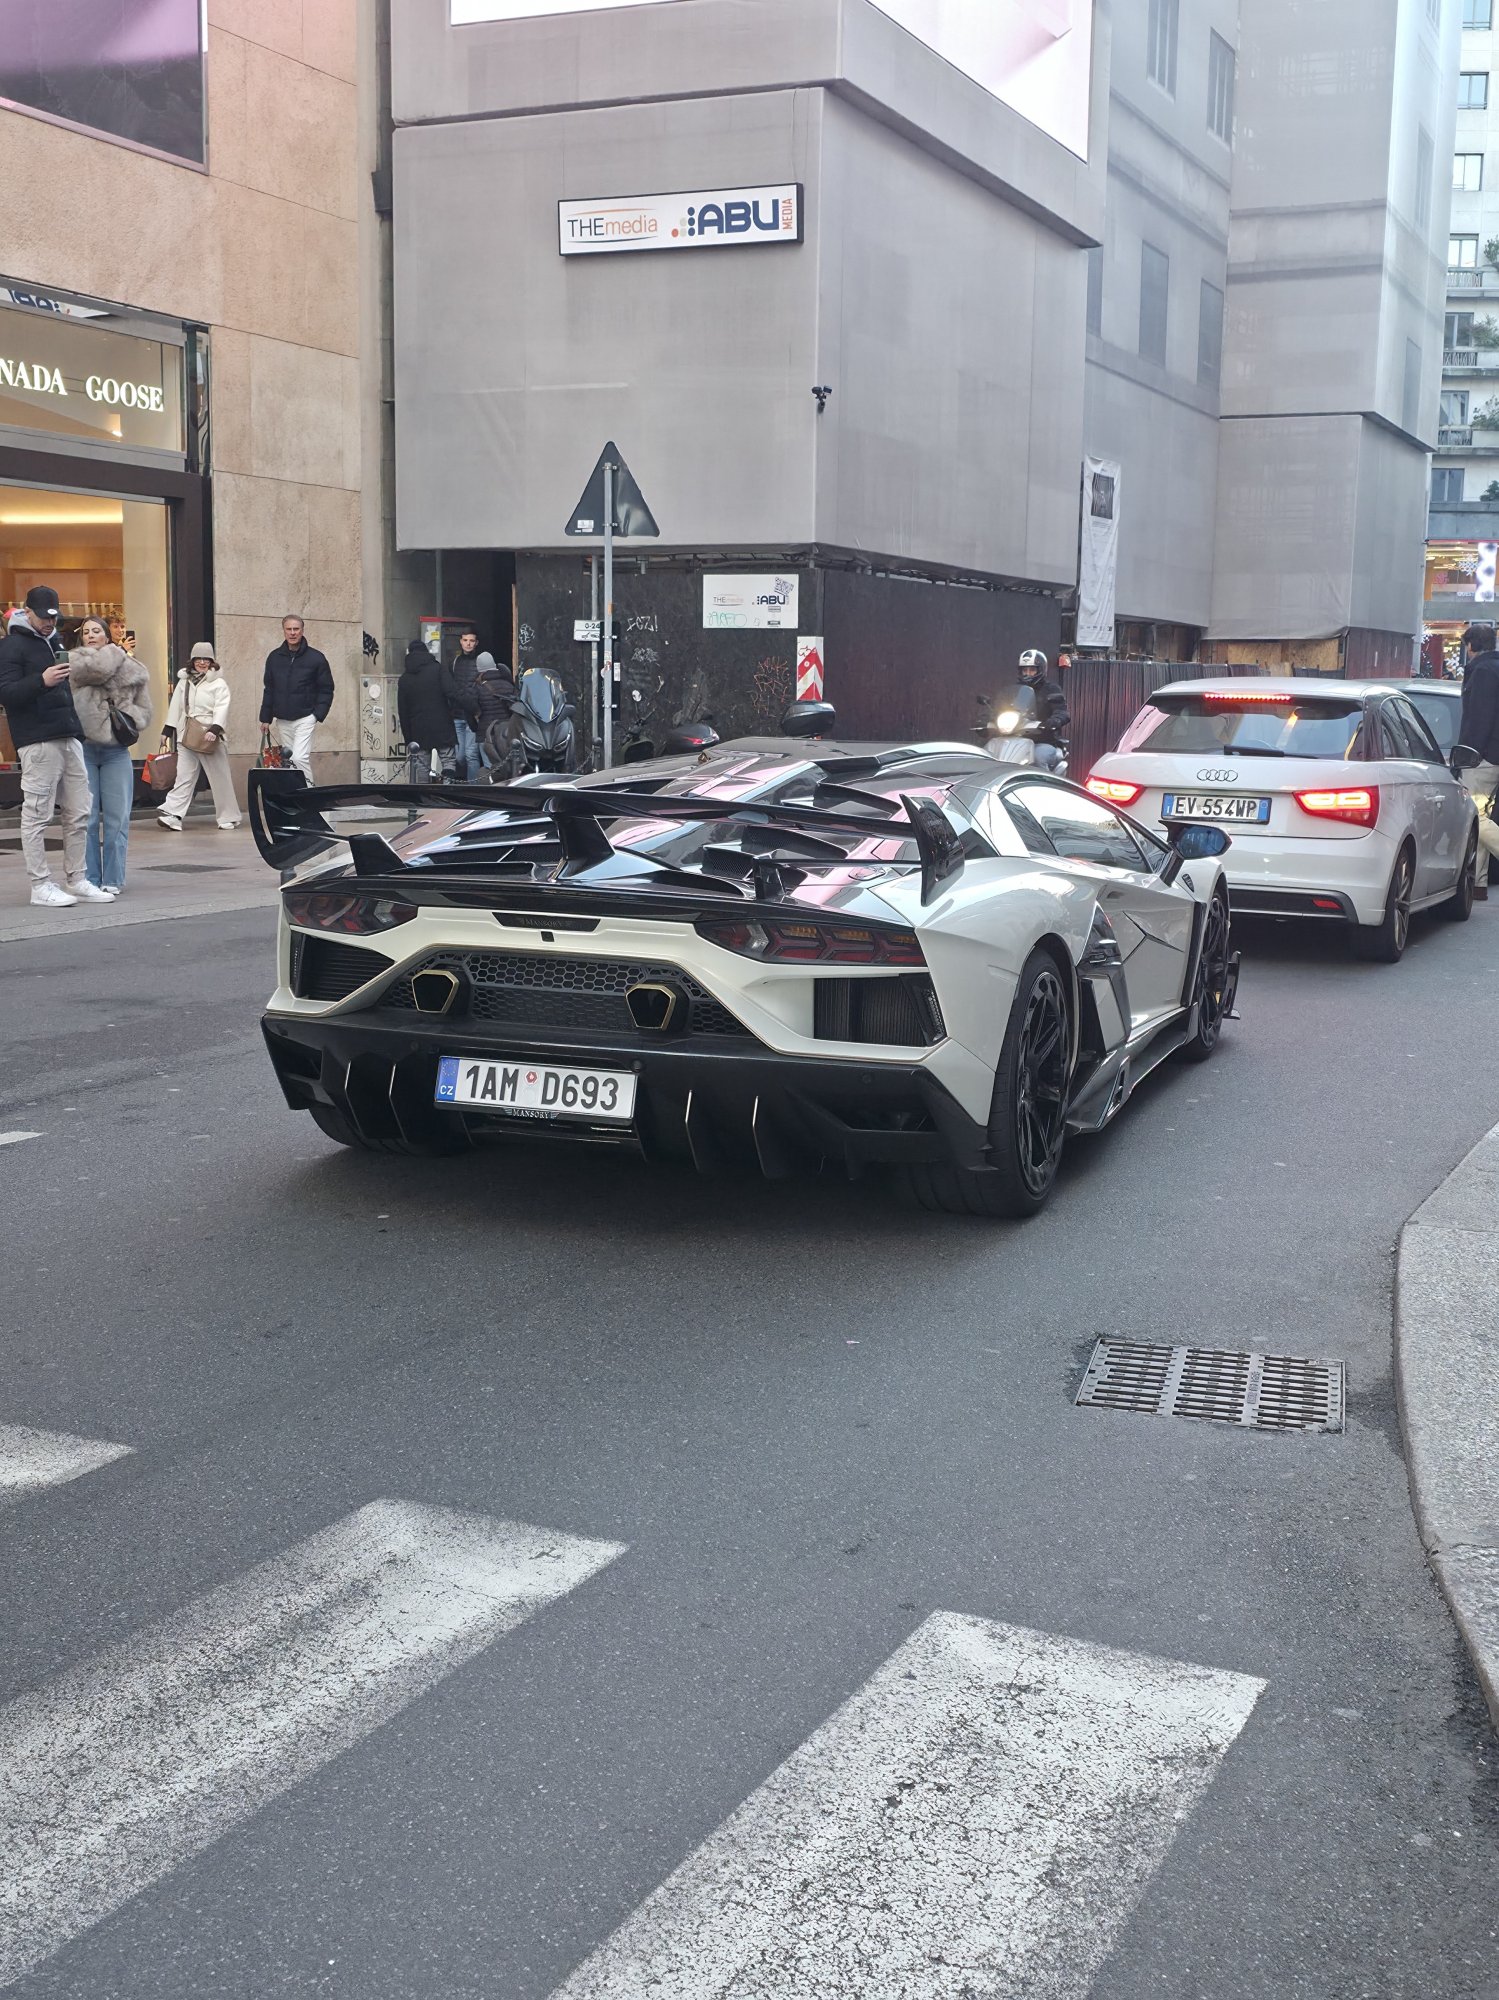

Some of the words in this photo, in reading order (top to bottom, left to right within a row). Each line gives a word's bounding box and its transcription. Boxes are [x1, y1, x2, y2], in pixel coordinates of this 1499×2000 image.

[781, 197, 793, 230] MEDIA
[567, 215, 658, 238] THEmedia
[85, 375, 164, 412] GOOSE
[1175, 797, 1197, 814] EV
[439, 1085, 453, 1096] CZ
[466, 1065, 520, 1102] 1AM
[541, 1071, 619, 1111] D693
[512, 1108, 550, 1119] MANSORY
